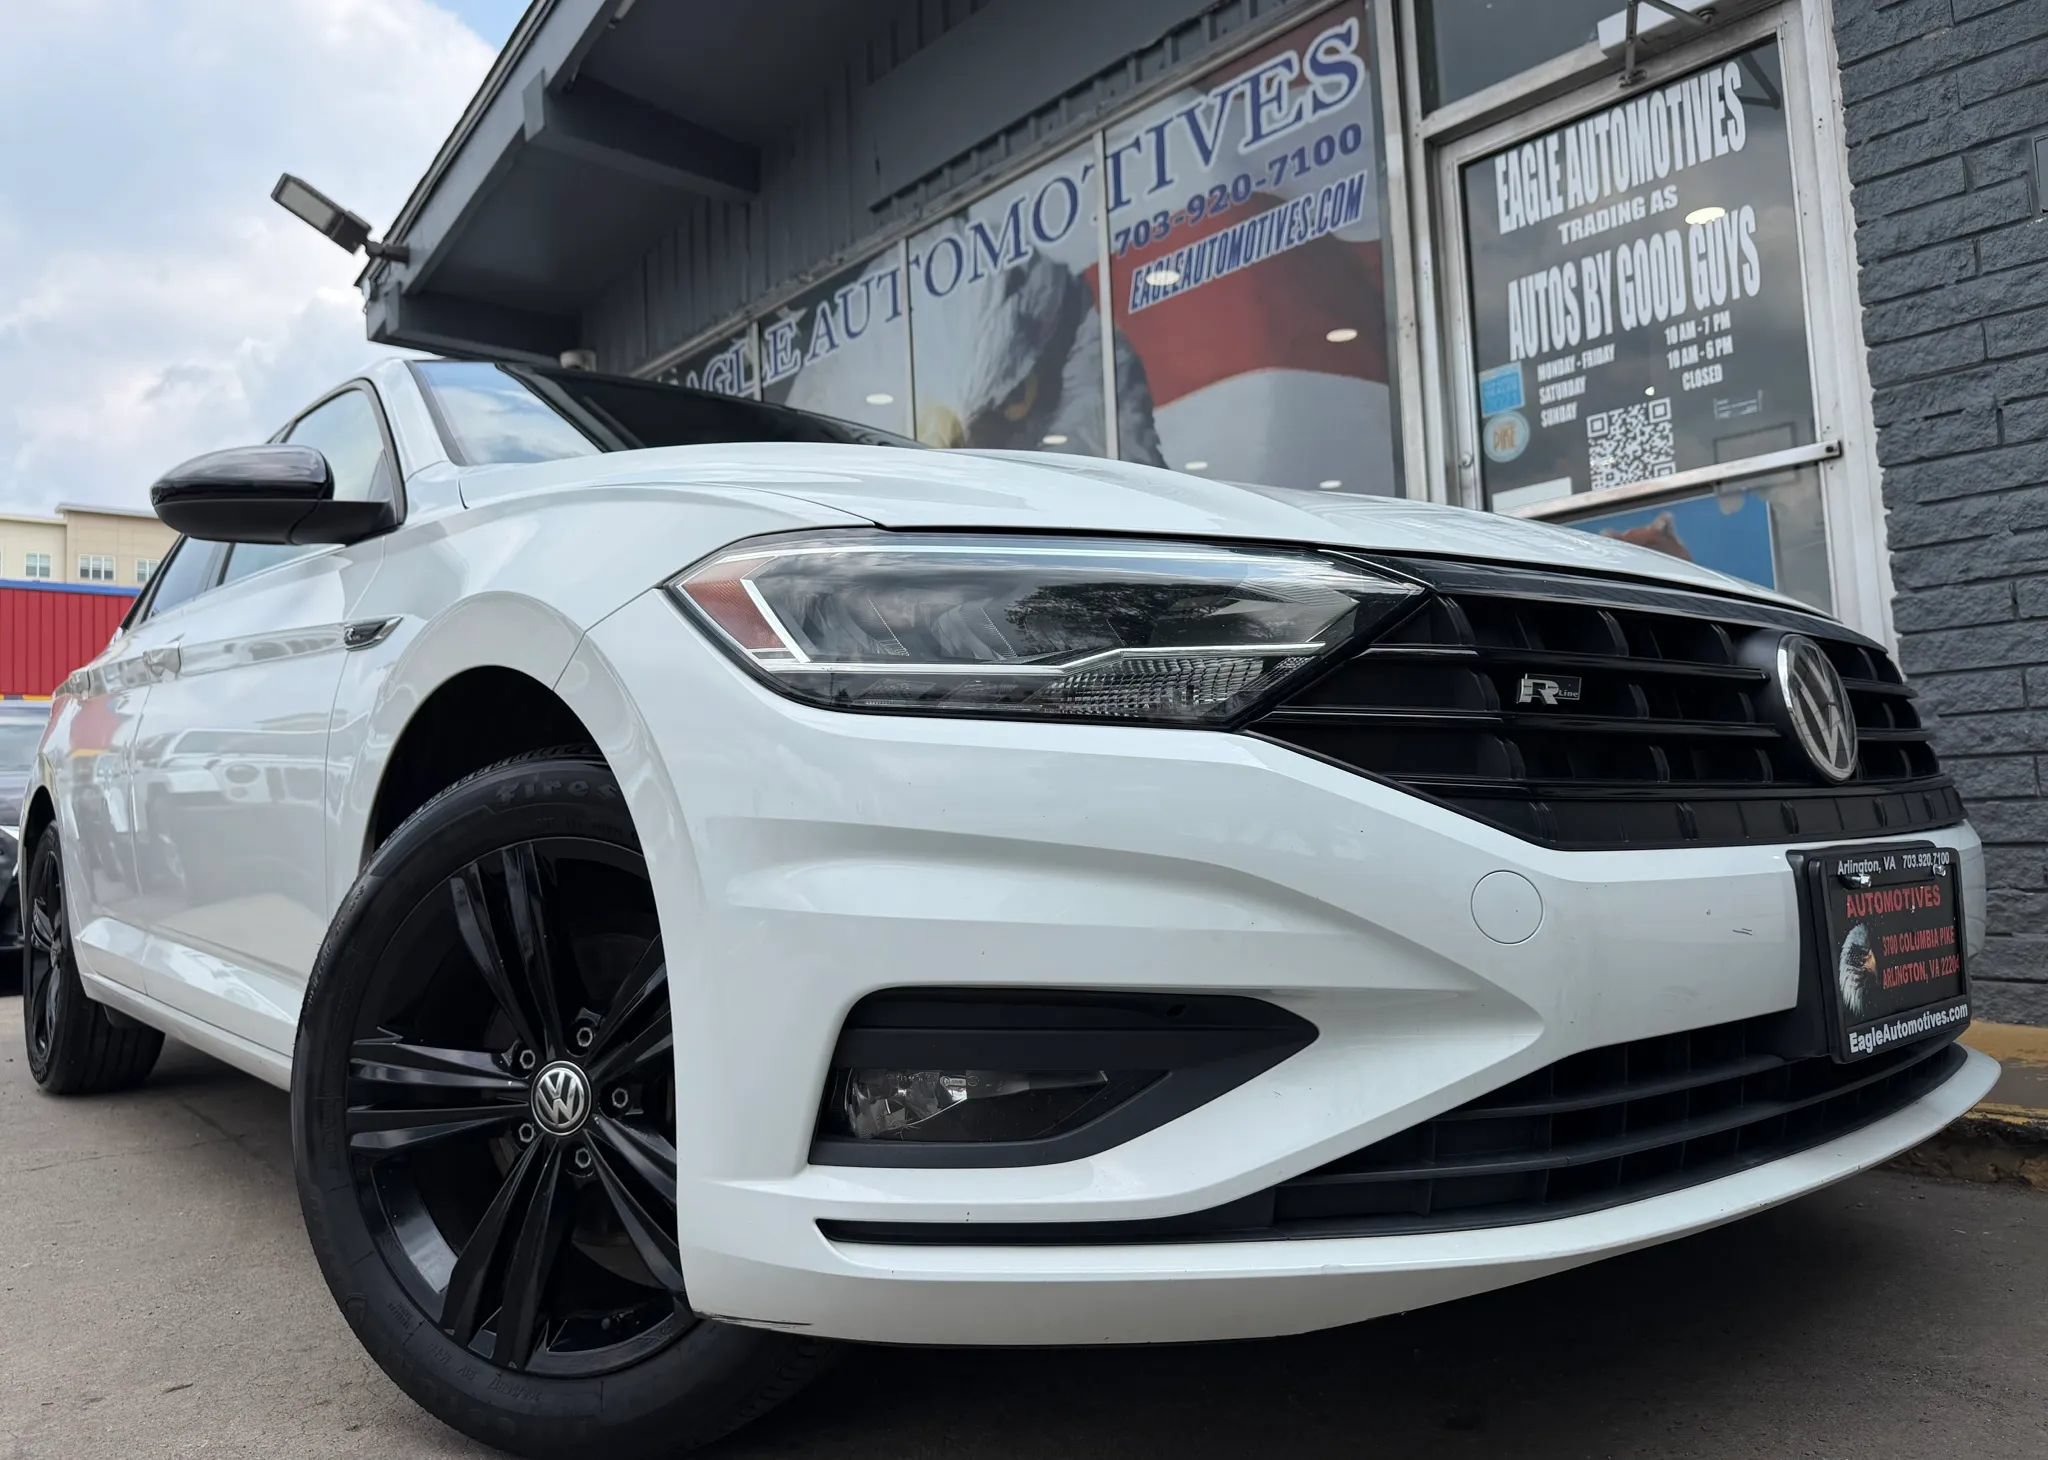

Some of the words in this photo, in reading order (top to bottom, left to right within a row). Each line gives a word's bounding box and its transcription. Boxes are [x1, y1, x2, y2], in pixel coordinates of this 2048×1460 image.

[1494, 133, 1564, 235] EAGLE
[1565, 61, 1746, 209] AUTOMOTIVES
[657, 318, 801, 398] GLE
[803, 17, 1366, 367] AUTOMOTIVES
[1114, 122, 1364, 257] 703-920-7100
[1558, 196, 1647, 246] TRADING
[1650, 184, 1679, 215] AS
[1128, 170, 1368, 315] EAGLEAUTOMOTIVES.COM
[1508, 261, 1581, 362] AUTOS
[1581, 250, 1613, 341] BY
[1617, 228, 1686, 332] GOOD
[1688, 204, 1761, 311] GUYS
[1664, 325, 1679, 346] 10
[1679, 320, 1697, 342] AM
[1702, 315, 1710, 335] 7
[1712, 309, 1731, 333] PM
[1537, 353, 1576, 383] MONDAY
[1581, 343, 1615, 370] FRIDAY
[1666, 349, 1681, 370] 10
[1681, 344, 1699, 367] AM
[1714, 334, 1734, 357] PM
[1539, 375, 1587, 405] SATURDAY
[1682, 362, 1723, 391] CLOSED
[1541, 400, 1577, 428] SUNDAY
[1518, 679, 1558, 704] R
[1837, 859, 1881, 876] Arlington,
[1883, 855, 1897, 871] VA
[1902, 851, 1950, 870] 703.920.7100
[1846, 884, 1941, 919] AUTOMOTIVES
[1899, 927, 1939, 953] COLUMBIA
[1882, 961, 1929, 990] ARLINGTON,
[1929, 957, 1940, 978] VA
[1848, 1003, 1969, 1054] EagleAutomotives.com
